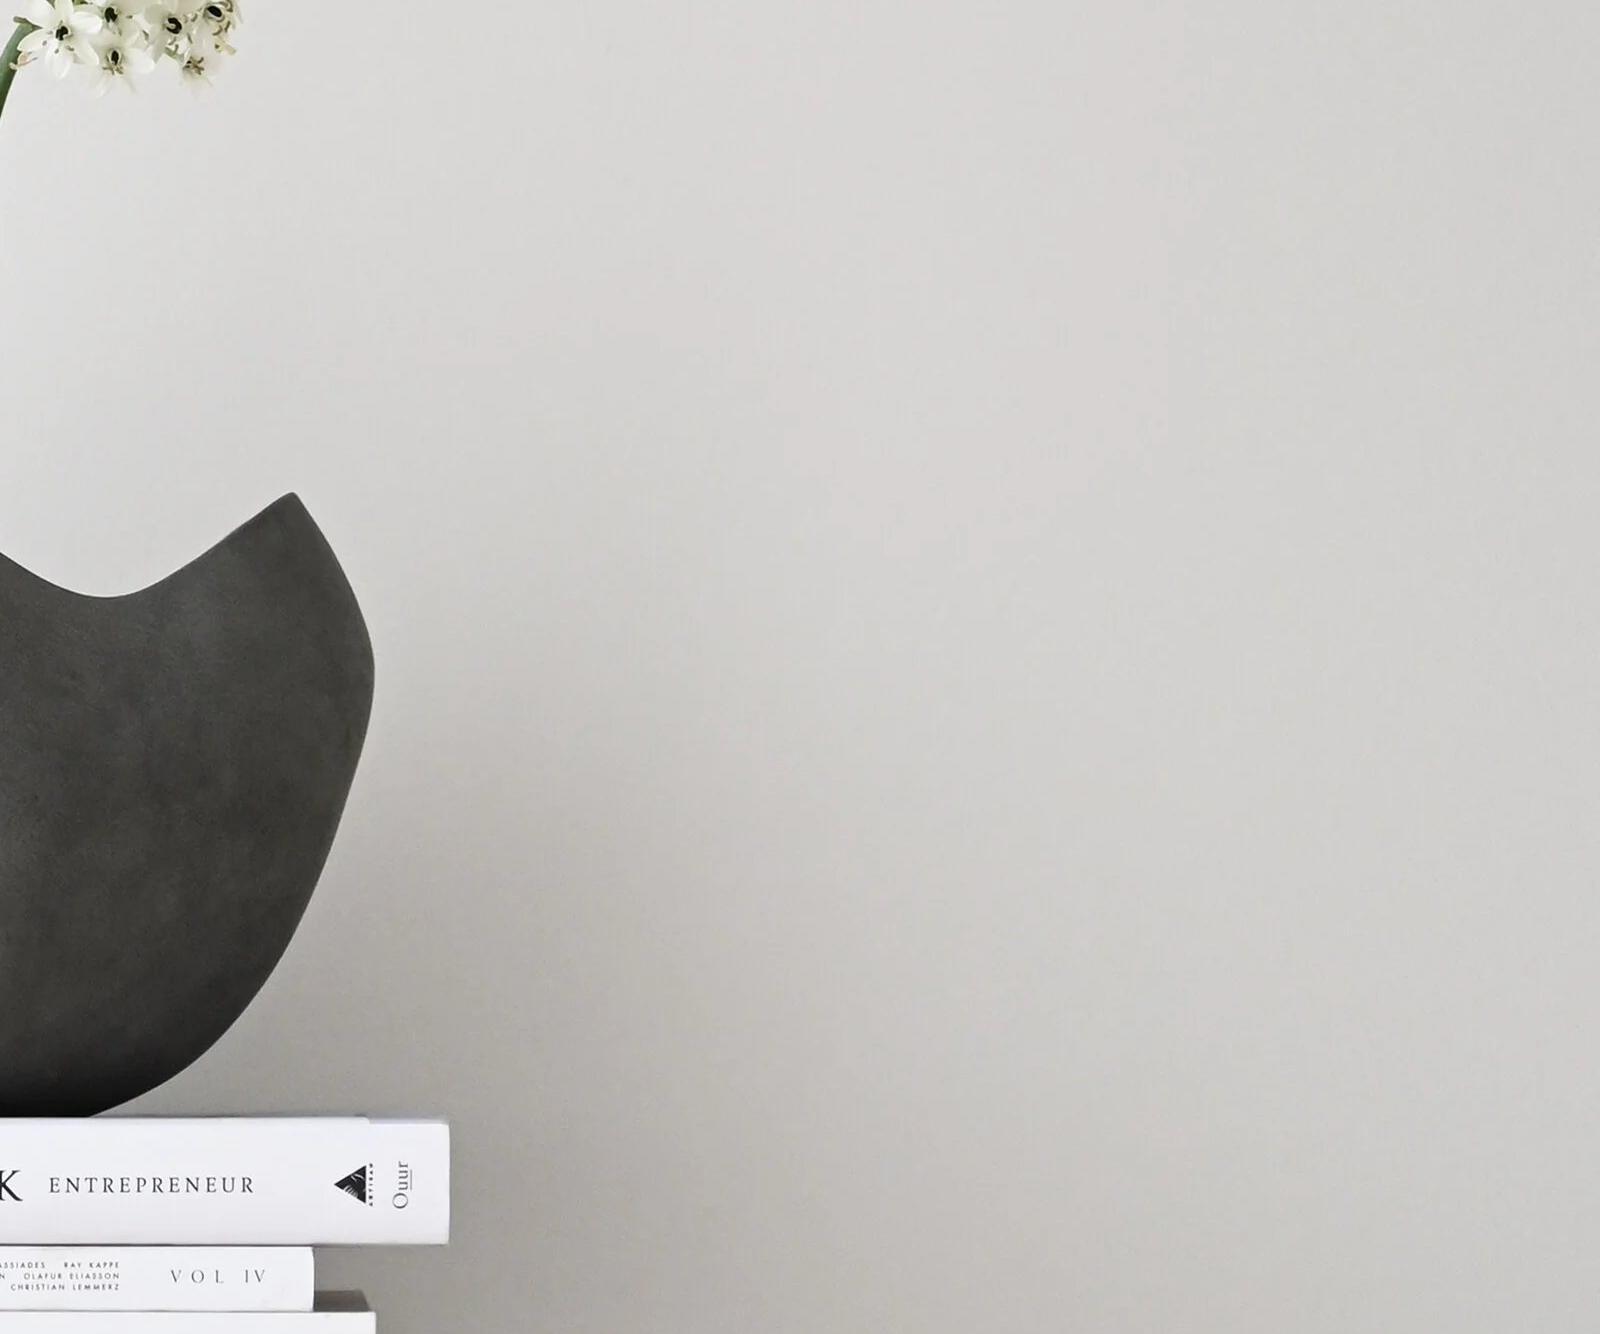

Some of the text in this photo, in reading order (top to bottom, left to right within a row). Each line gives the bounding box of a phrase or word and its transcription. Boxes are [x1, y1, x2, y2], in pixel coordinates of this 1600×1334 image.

[48, 1176, 254, 1194] ENTREPRENEUR
[391, 1160, 410, 1210] Ouur
[63, 1261, 82, 1269] RAY
[88, 1261, 119, 1269] KAPPE
[23, 1272, 63, 1281] OLAFUR
[69, 1272, 120, 1281] ELIASSON
[170, 1268, 266, 1284] VOL IV
[10, 1282, 66, 1292] CHRISTIAN
[72, 1282, 120, 1291] LEMMERZ
